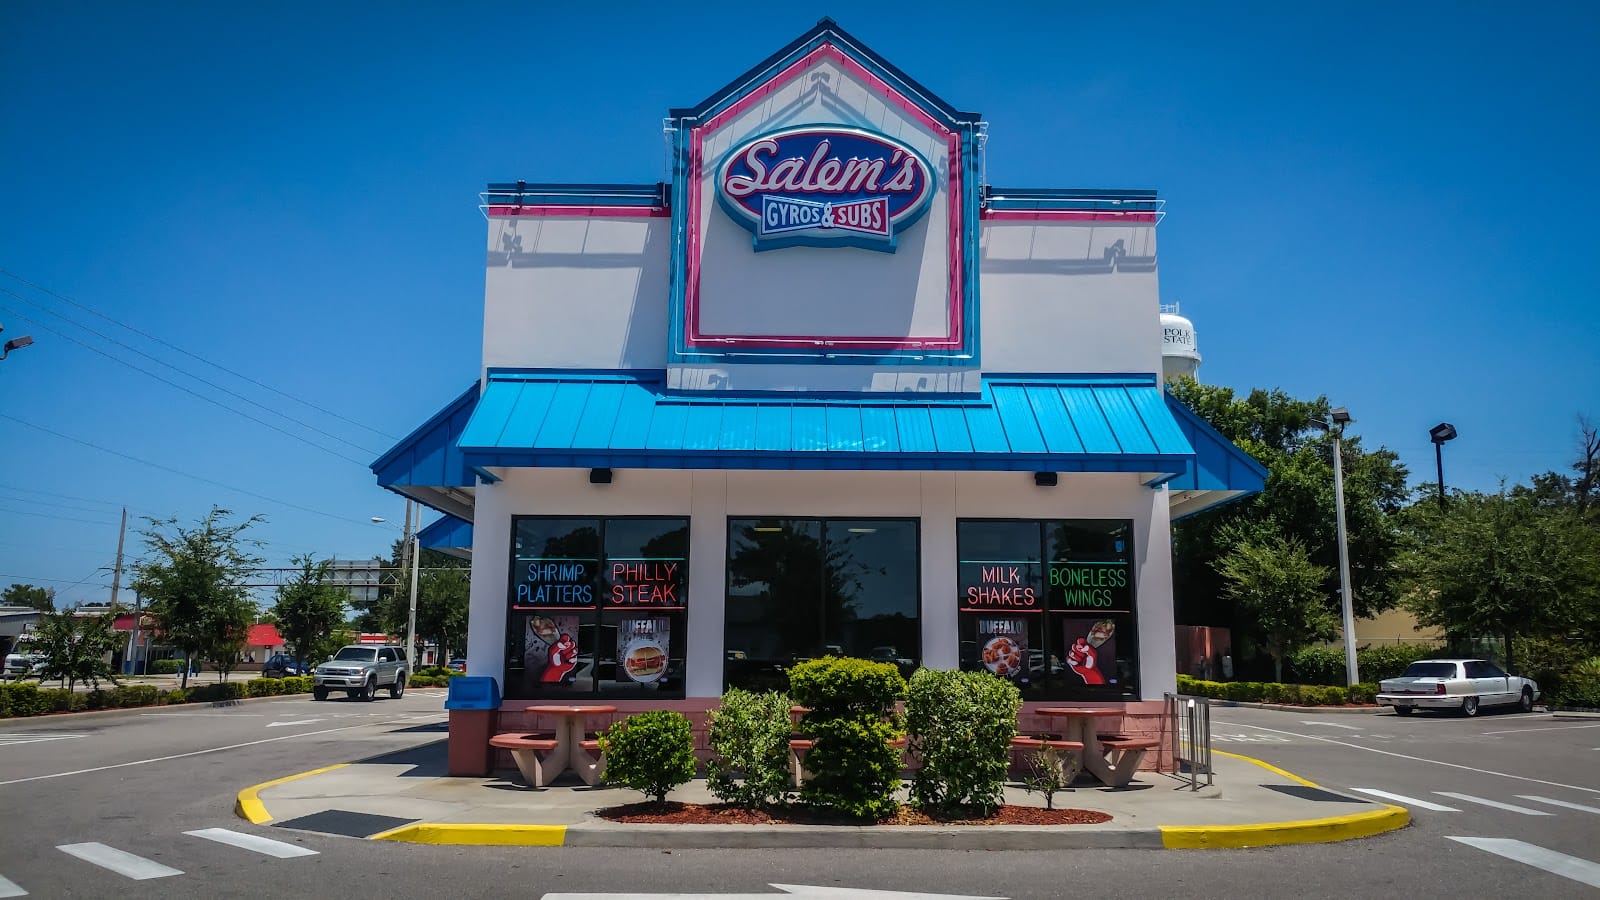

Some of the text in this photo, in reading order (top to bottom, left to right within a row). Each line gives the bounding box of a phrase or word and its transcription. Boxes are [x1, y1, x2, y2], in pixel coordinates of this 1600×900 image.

[726, 139, 916, 196] Salem's
[766, 202, 882, 229] GYROS & SUBS
[1163, 335, 1192, 345] STATE
[1164, 328, 1190, 337] POLK
[527, 563, 585, 582] SHRIMP
[612, 563, 677, 581] PHILLY
[982, 566, 1020, 584] MILK
[1050, 567, 1127, 587] BONELESS
[517, 584, 593, 603] PLATTERS
[612, 584, 677, 604] STEAK
[967, 586, 1035, 606] SHAKES
[1064, 589, 1113, 607] WINGS
